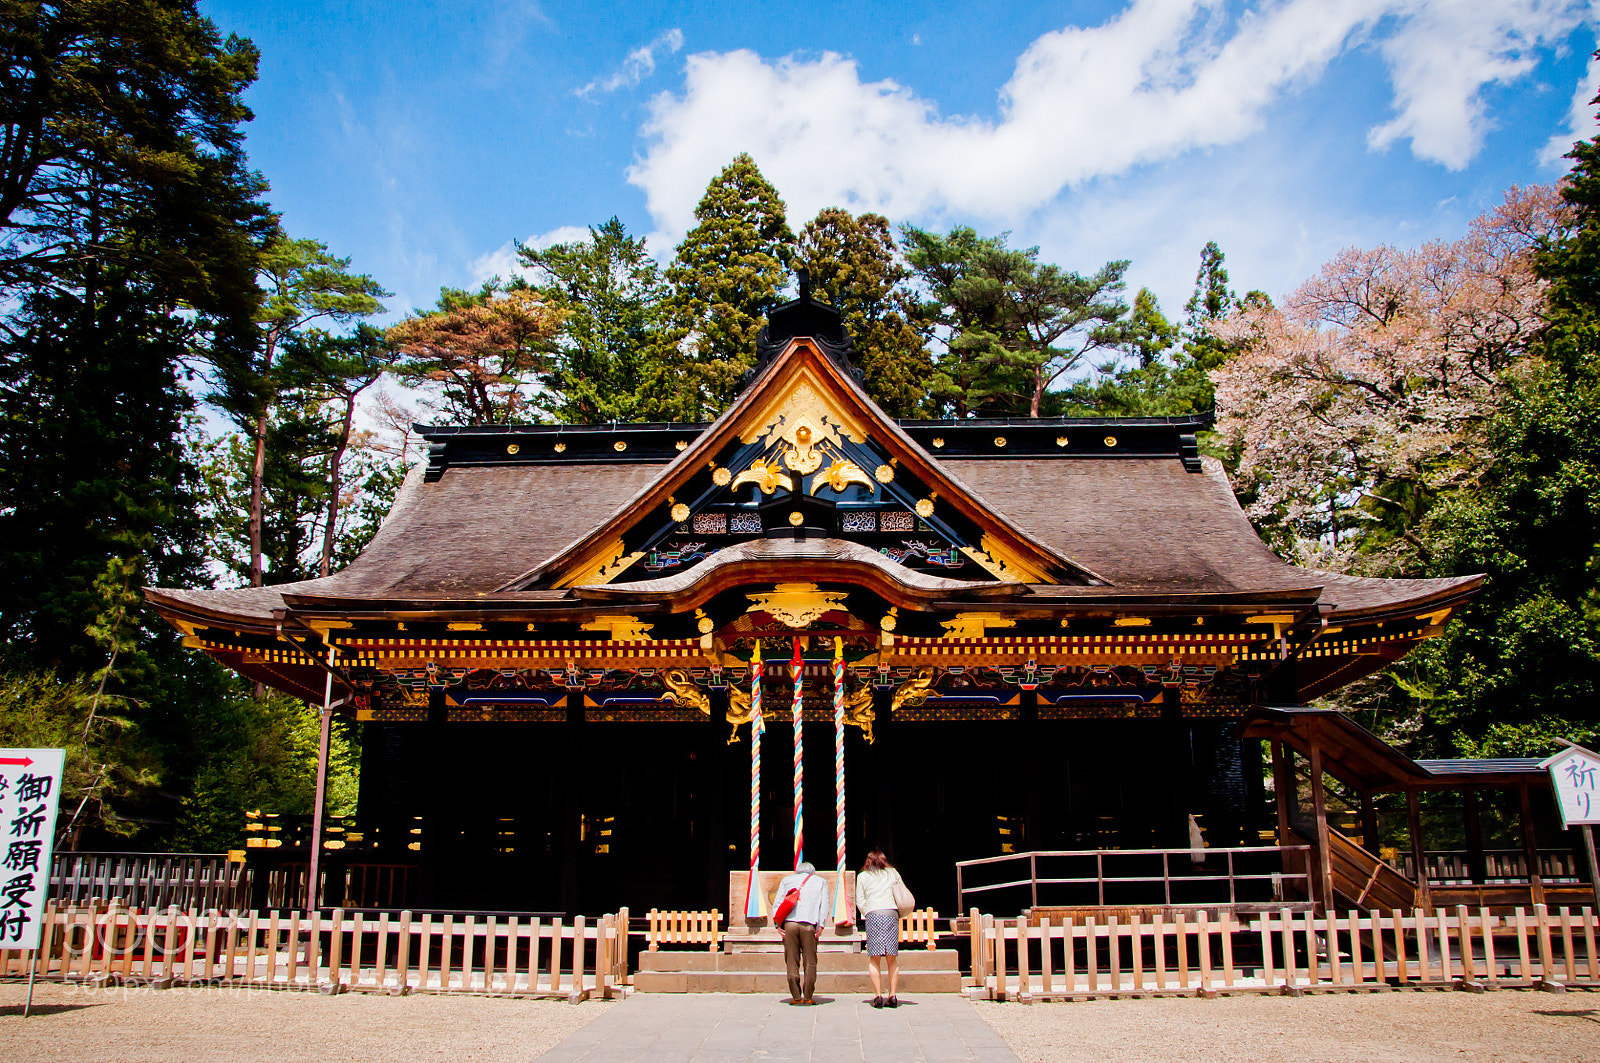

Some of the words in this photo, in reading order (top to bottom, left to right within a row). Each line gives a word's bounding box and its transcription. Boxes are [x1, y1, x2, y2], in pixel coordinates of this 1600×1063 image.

[1564, 758, 1597, 819] 祈り
[0, 773, 53, 942] 御祈願受付
